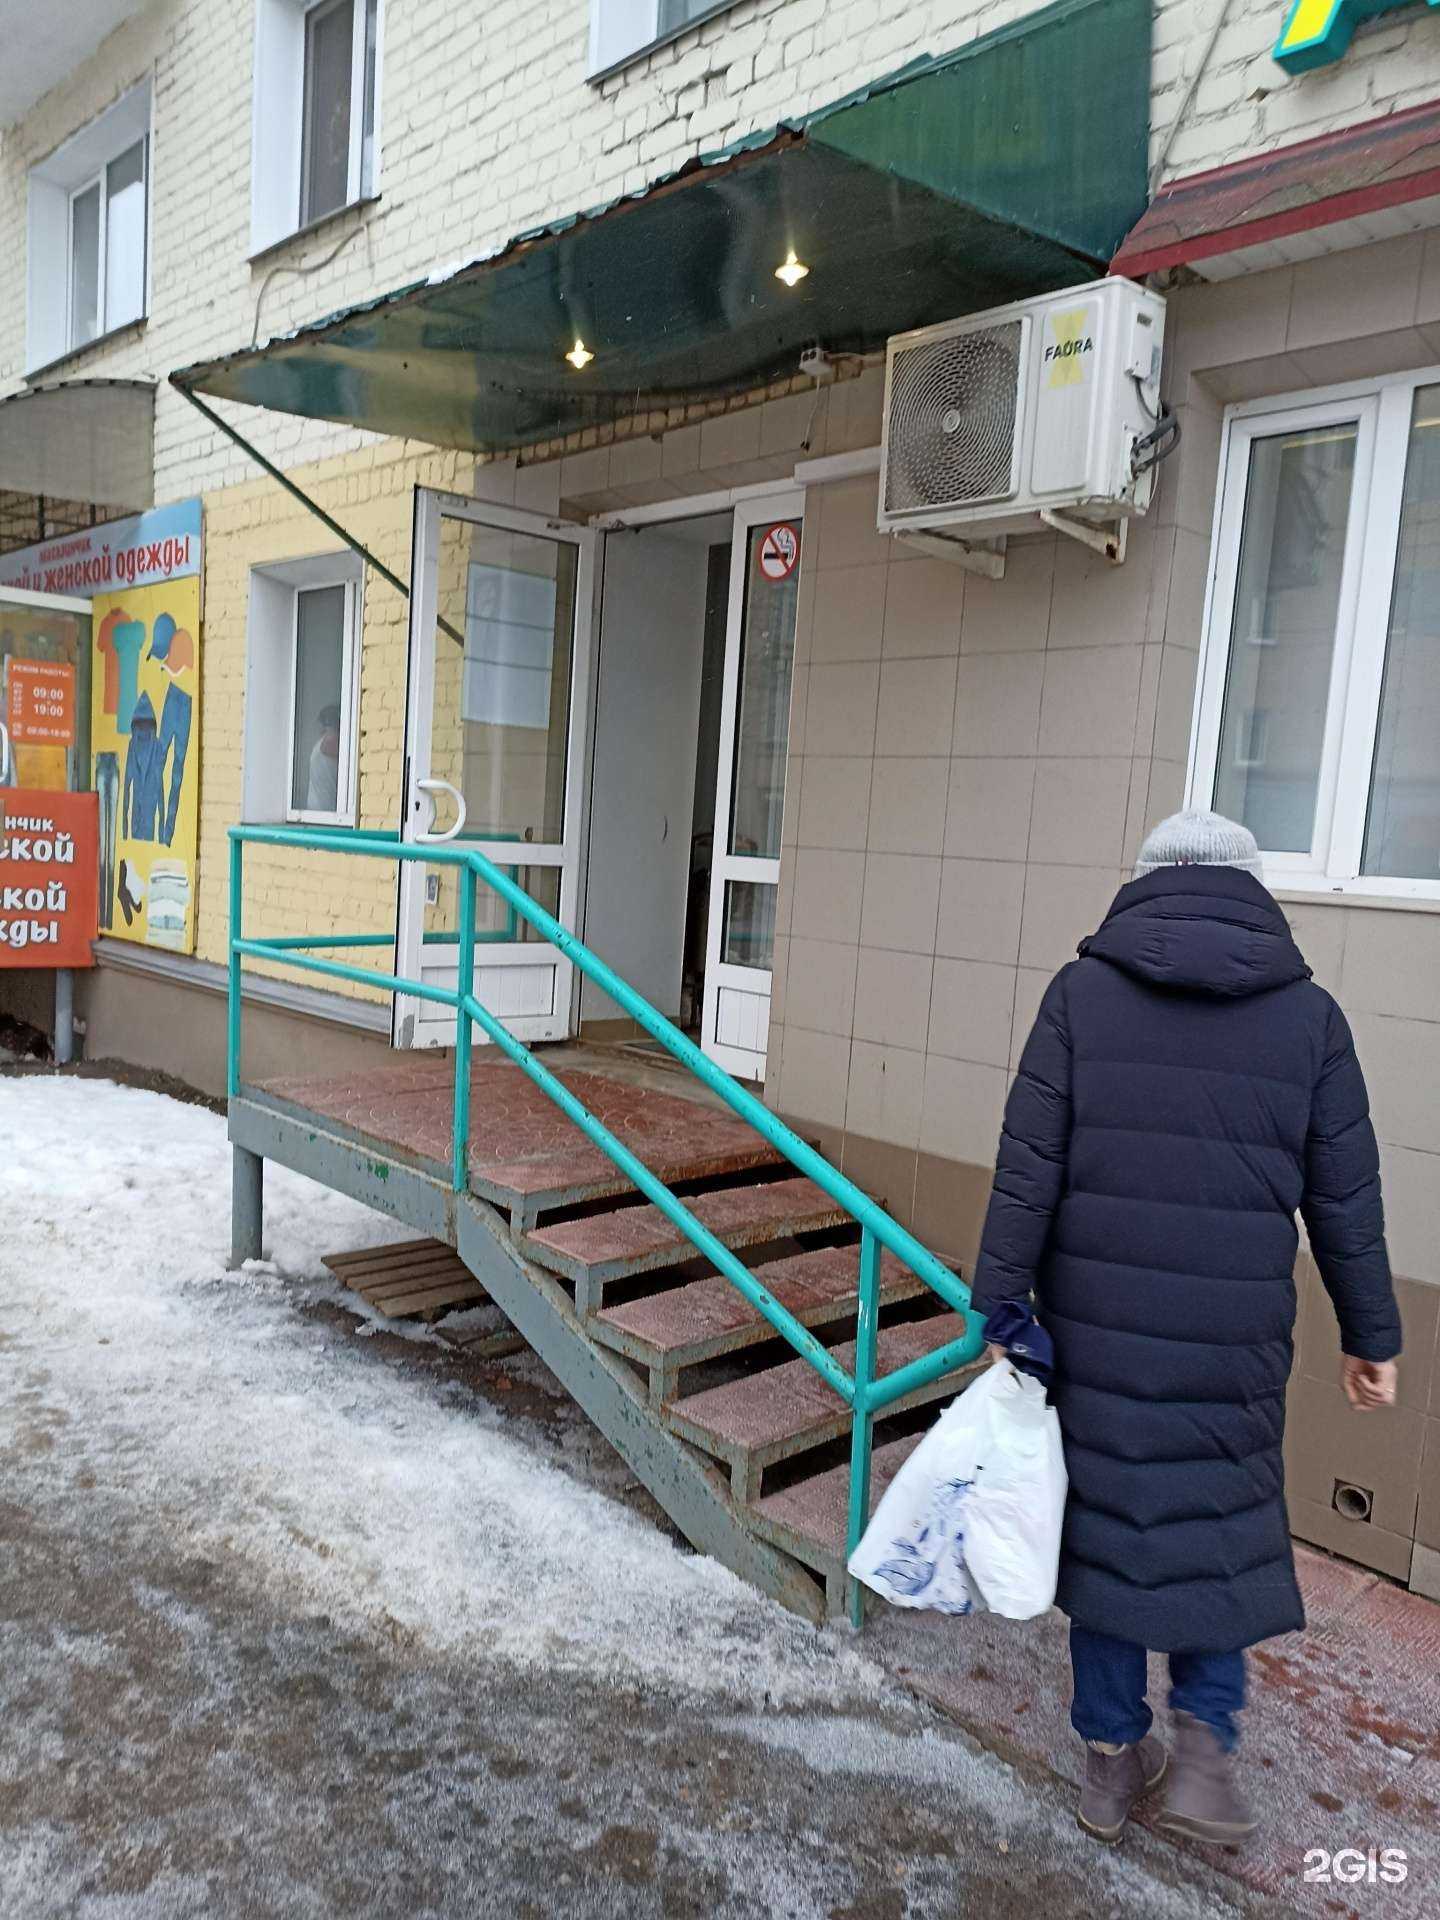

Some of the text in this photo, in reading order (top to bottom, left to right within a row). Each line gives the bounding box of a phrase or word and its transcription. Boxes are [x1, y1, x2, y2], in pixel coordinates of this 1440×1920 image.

[44, 544, 112, 593] женской
[115, 535, 190, 584] одежды
[33, 686, 64, 701] 09:00
[33, 703, 64, 718] 19:00
[0, 881, 67, 912] кой
